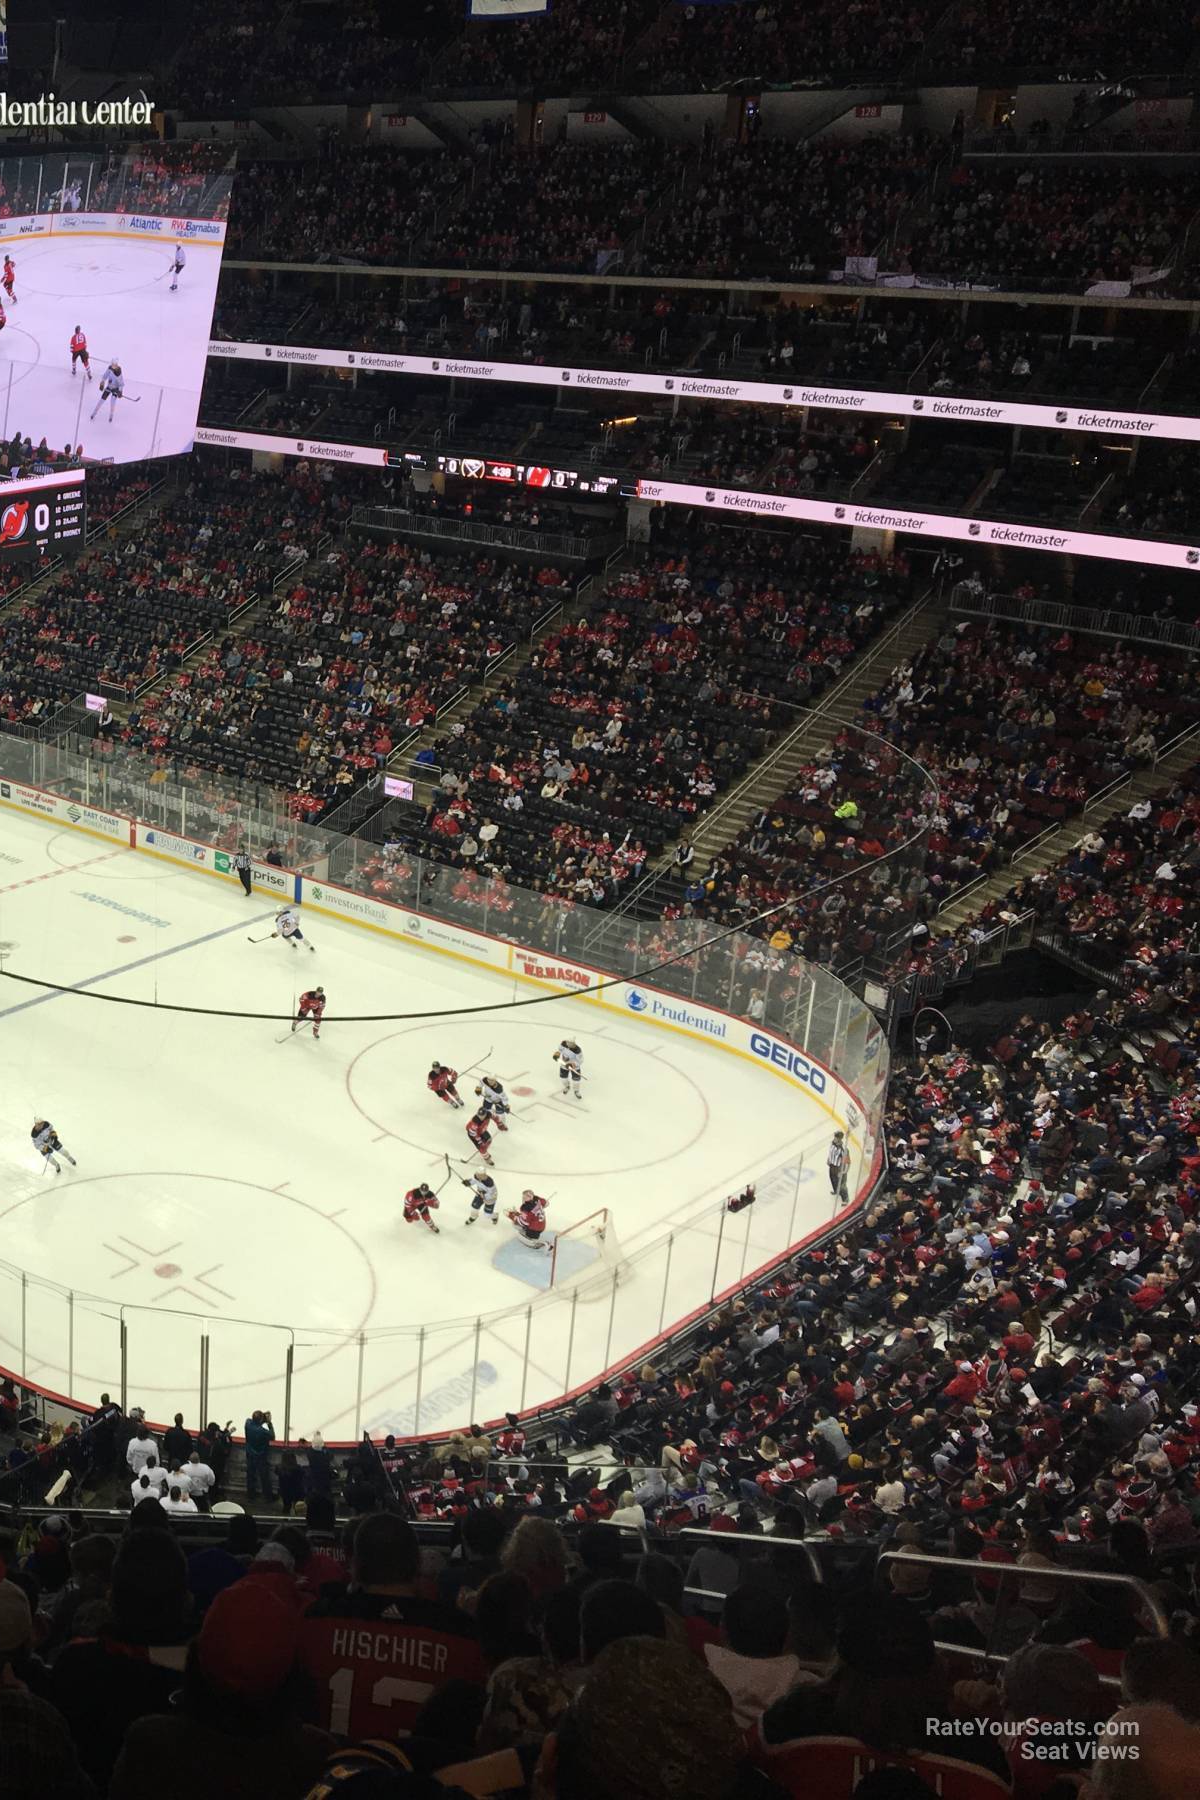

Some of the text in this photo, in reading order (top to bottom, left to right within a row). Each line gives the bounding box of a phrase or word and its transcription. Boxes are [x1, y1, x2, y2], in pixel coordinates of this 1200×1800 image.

[83, 96, 155, 125] Center
[130, 217, 162, 230] Atlantic
[276, 349, 318, 361] ticketmaster
[360, 357, 405, 369] ticketmaster
[445, 363, 494, 376] ticketmaster
[577, 374, 631, 387] ticketmaster
[681, 382, 739, 396] ticketmaster
[801, 391, 864, 407] ticketmaster
[933, 401, 1003, 418] ticketmaster
[1077, 414, 1155, 432] ticketmaster
[197, 431, 237, 444] ticketmaster
[309, 445, 354, 459] ticketmaster
[63, 491, 81, 500] GREENE
[723, 494, 786, 512] ticketmaster
[63, 503, 84, 513] LOVEJOY
[35, 503, 49, 532] 0
[63, 516, 78, 525] ZAJAC
[854, 510, 925, 529] ticketmaster
[990, 528, 1068, 547] ticketmaster
[40, 547, 45, 555] 7
[84, 810, 119, 827] EAST COAST
[523, 962, 591, 987] W.B.MASON
[652, 1000, 726, 1037] Prudential
[750, 1033, 826, 1094] GEICO
[332, 1628, 449, 1673] HISCHIER
